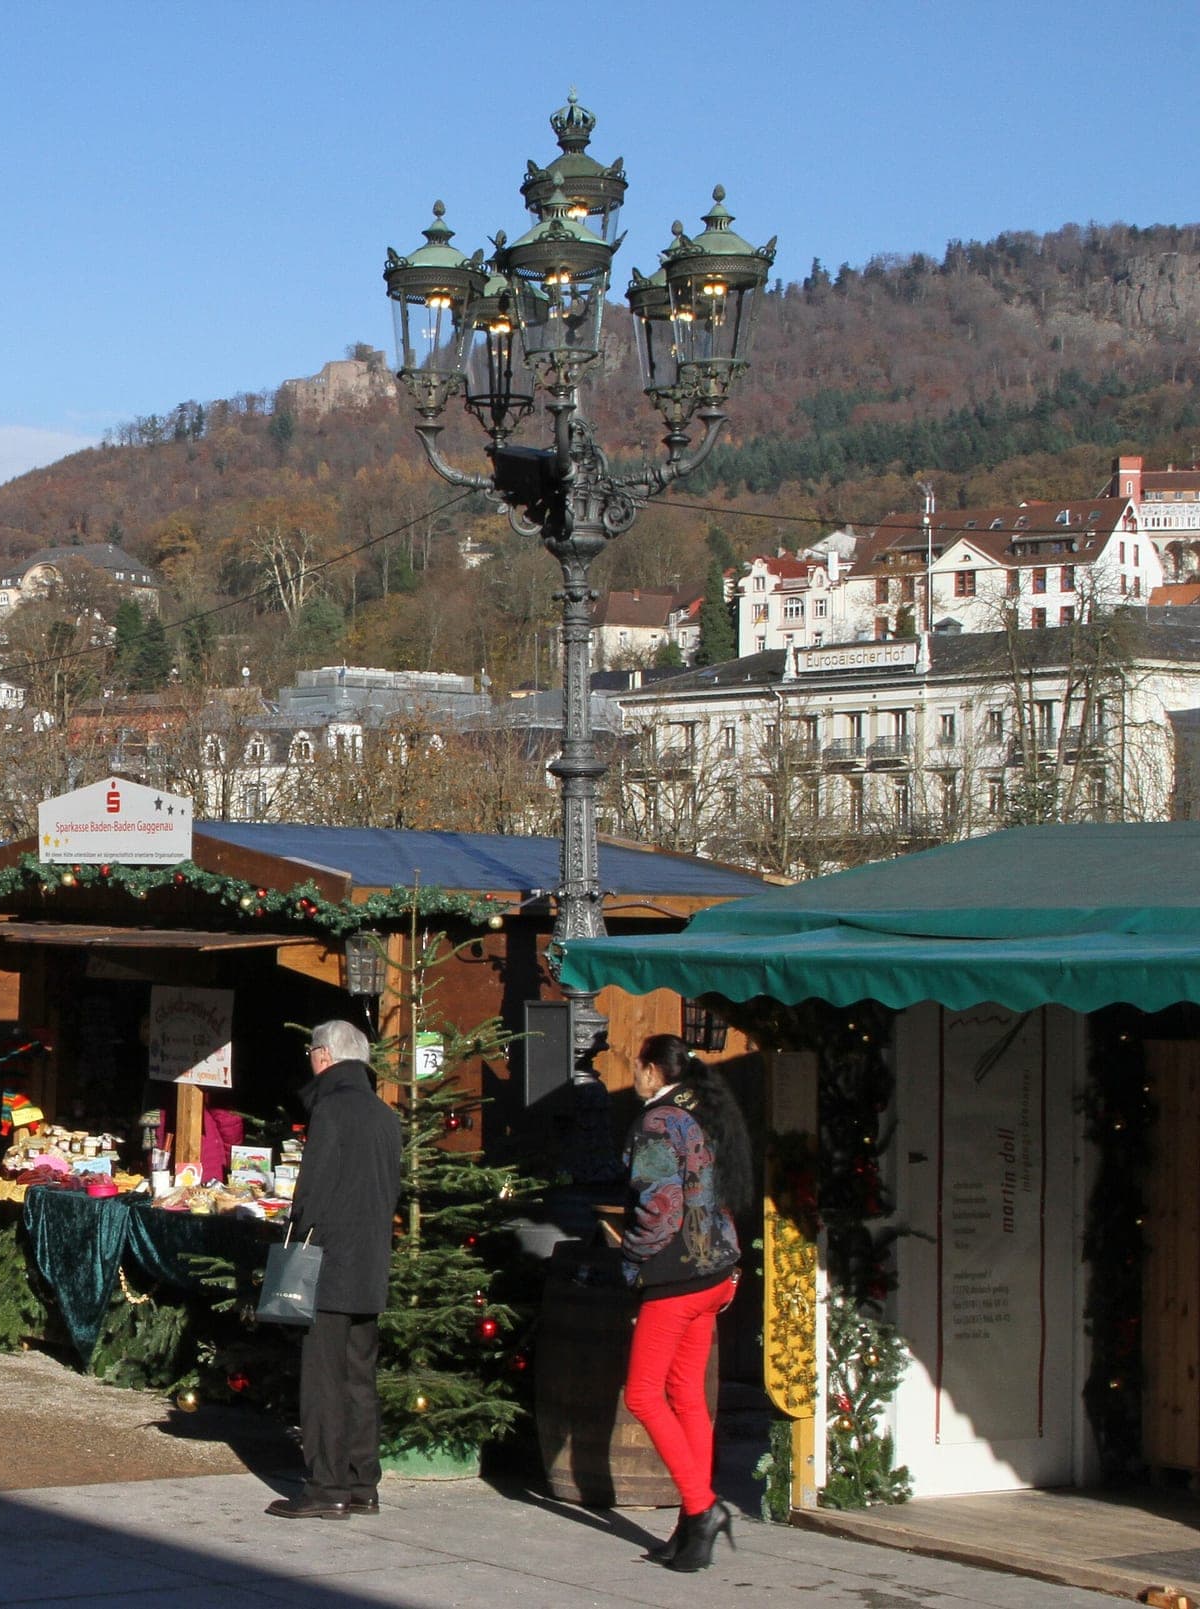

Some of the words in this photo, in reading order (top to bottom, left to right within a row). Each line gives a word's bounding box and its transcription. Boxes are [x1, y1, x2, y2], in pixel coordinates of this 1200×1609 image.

[806, 648, 882, 668] Europäischer
[884, 645, 906, 663] Hof
[55, 821, 89, 834] Sparkasse
[90, 821, 136, 832] Baden-Baden
[136, 820, 174, 835] Gaggenau
[423, 1053, 438, 1068] 73
[997, 1127, 1016, 1164] doll
[1000, 1171, 1017, 1234] martin
